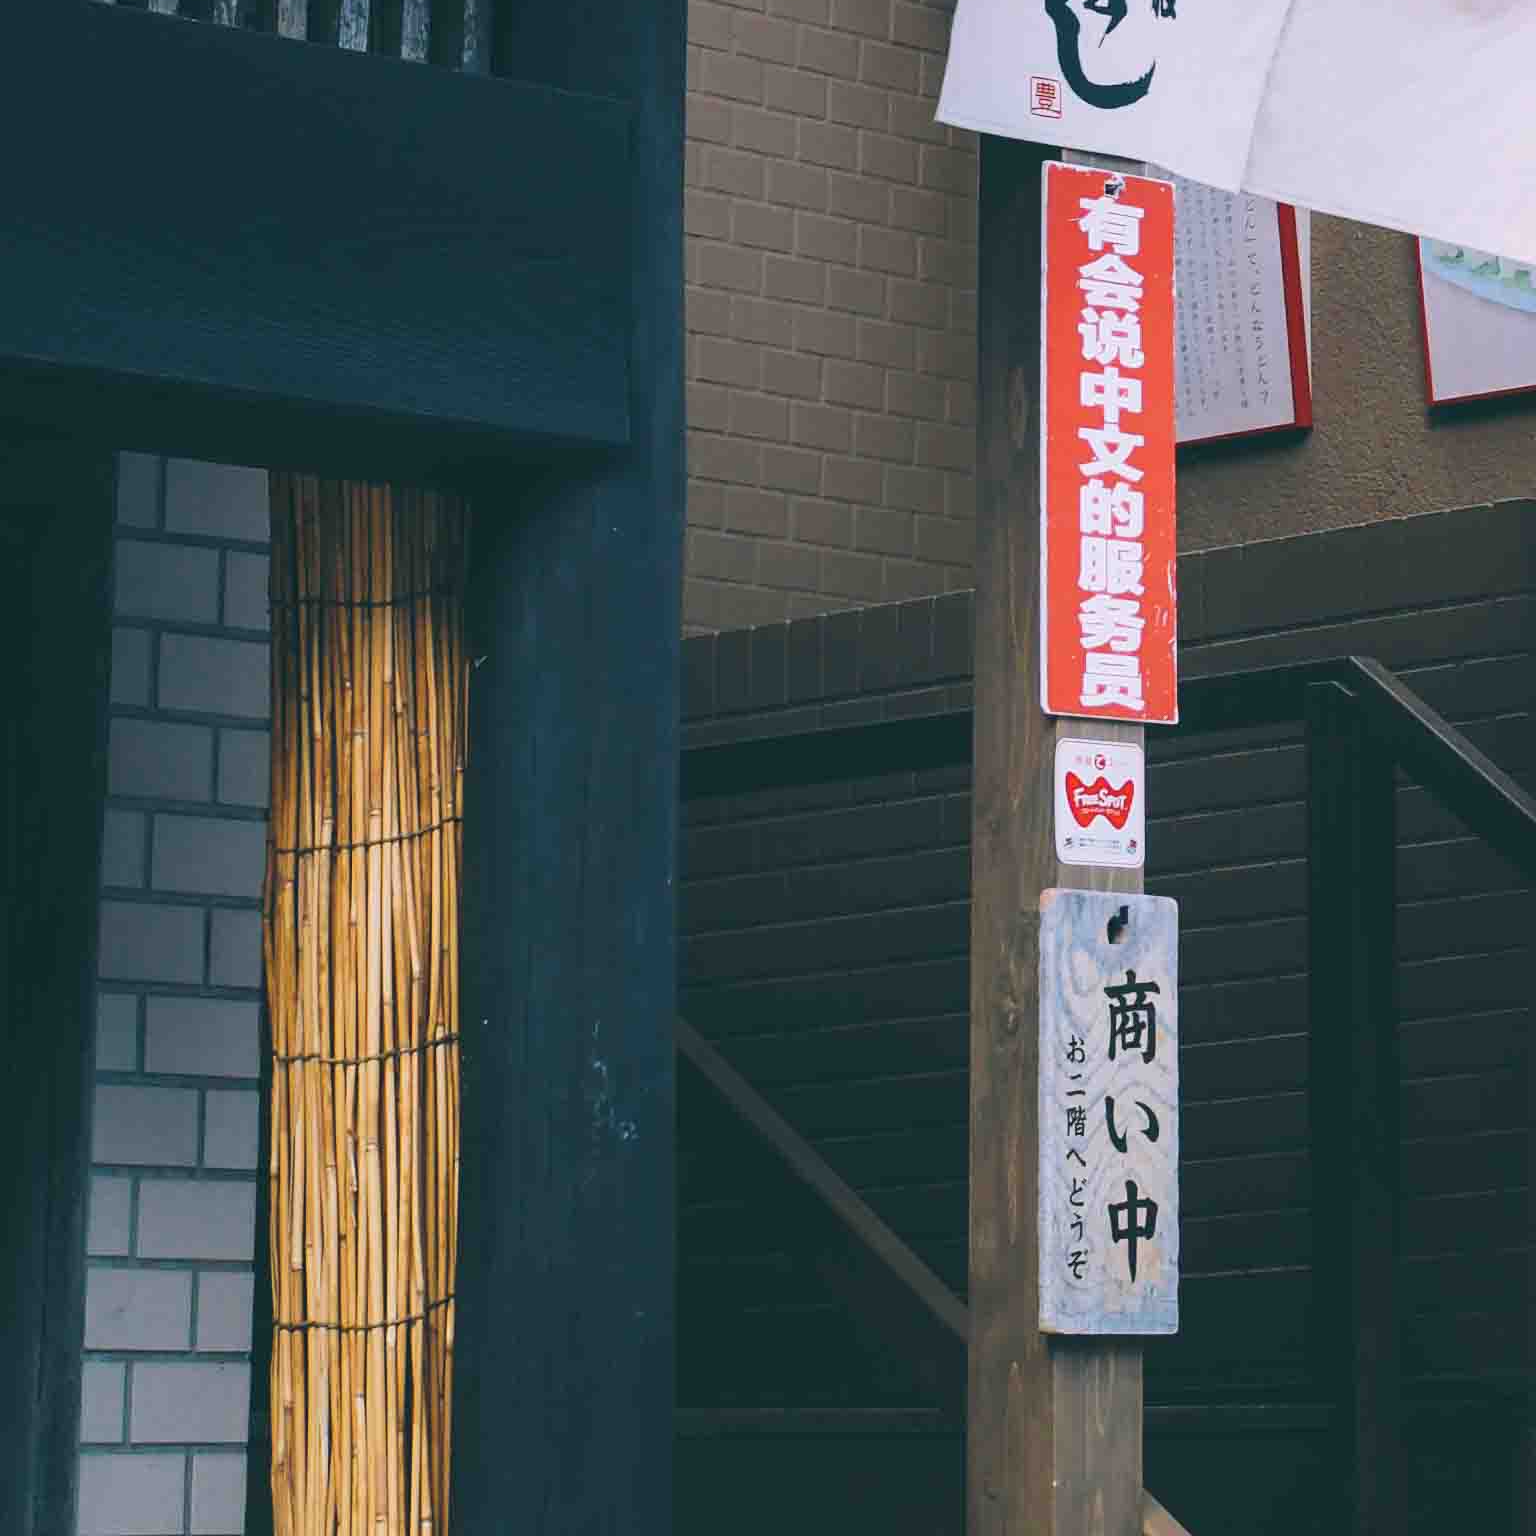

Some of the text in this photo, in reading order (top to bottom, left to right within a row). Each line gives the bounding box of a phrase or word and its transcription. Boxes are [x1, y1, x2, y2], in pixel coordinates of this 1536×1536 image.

[1079, 195, 1146, 711] 有会说中文的服务员
[1065, 1035, 1090, 1281] お二階へどうぞ
[1103, 969, 1161, 1284] 商い中
